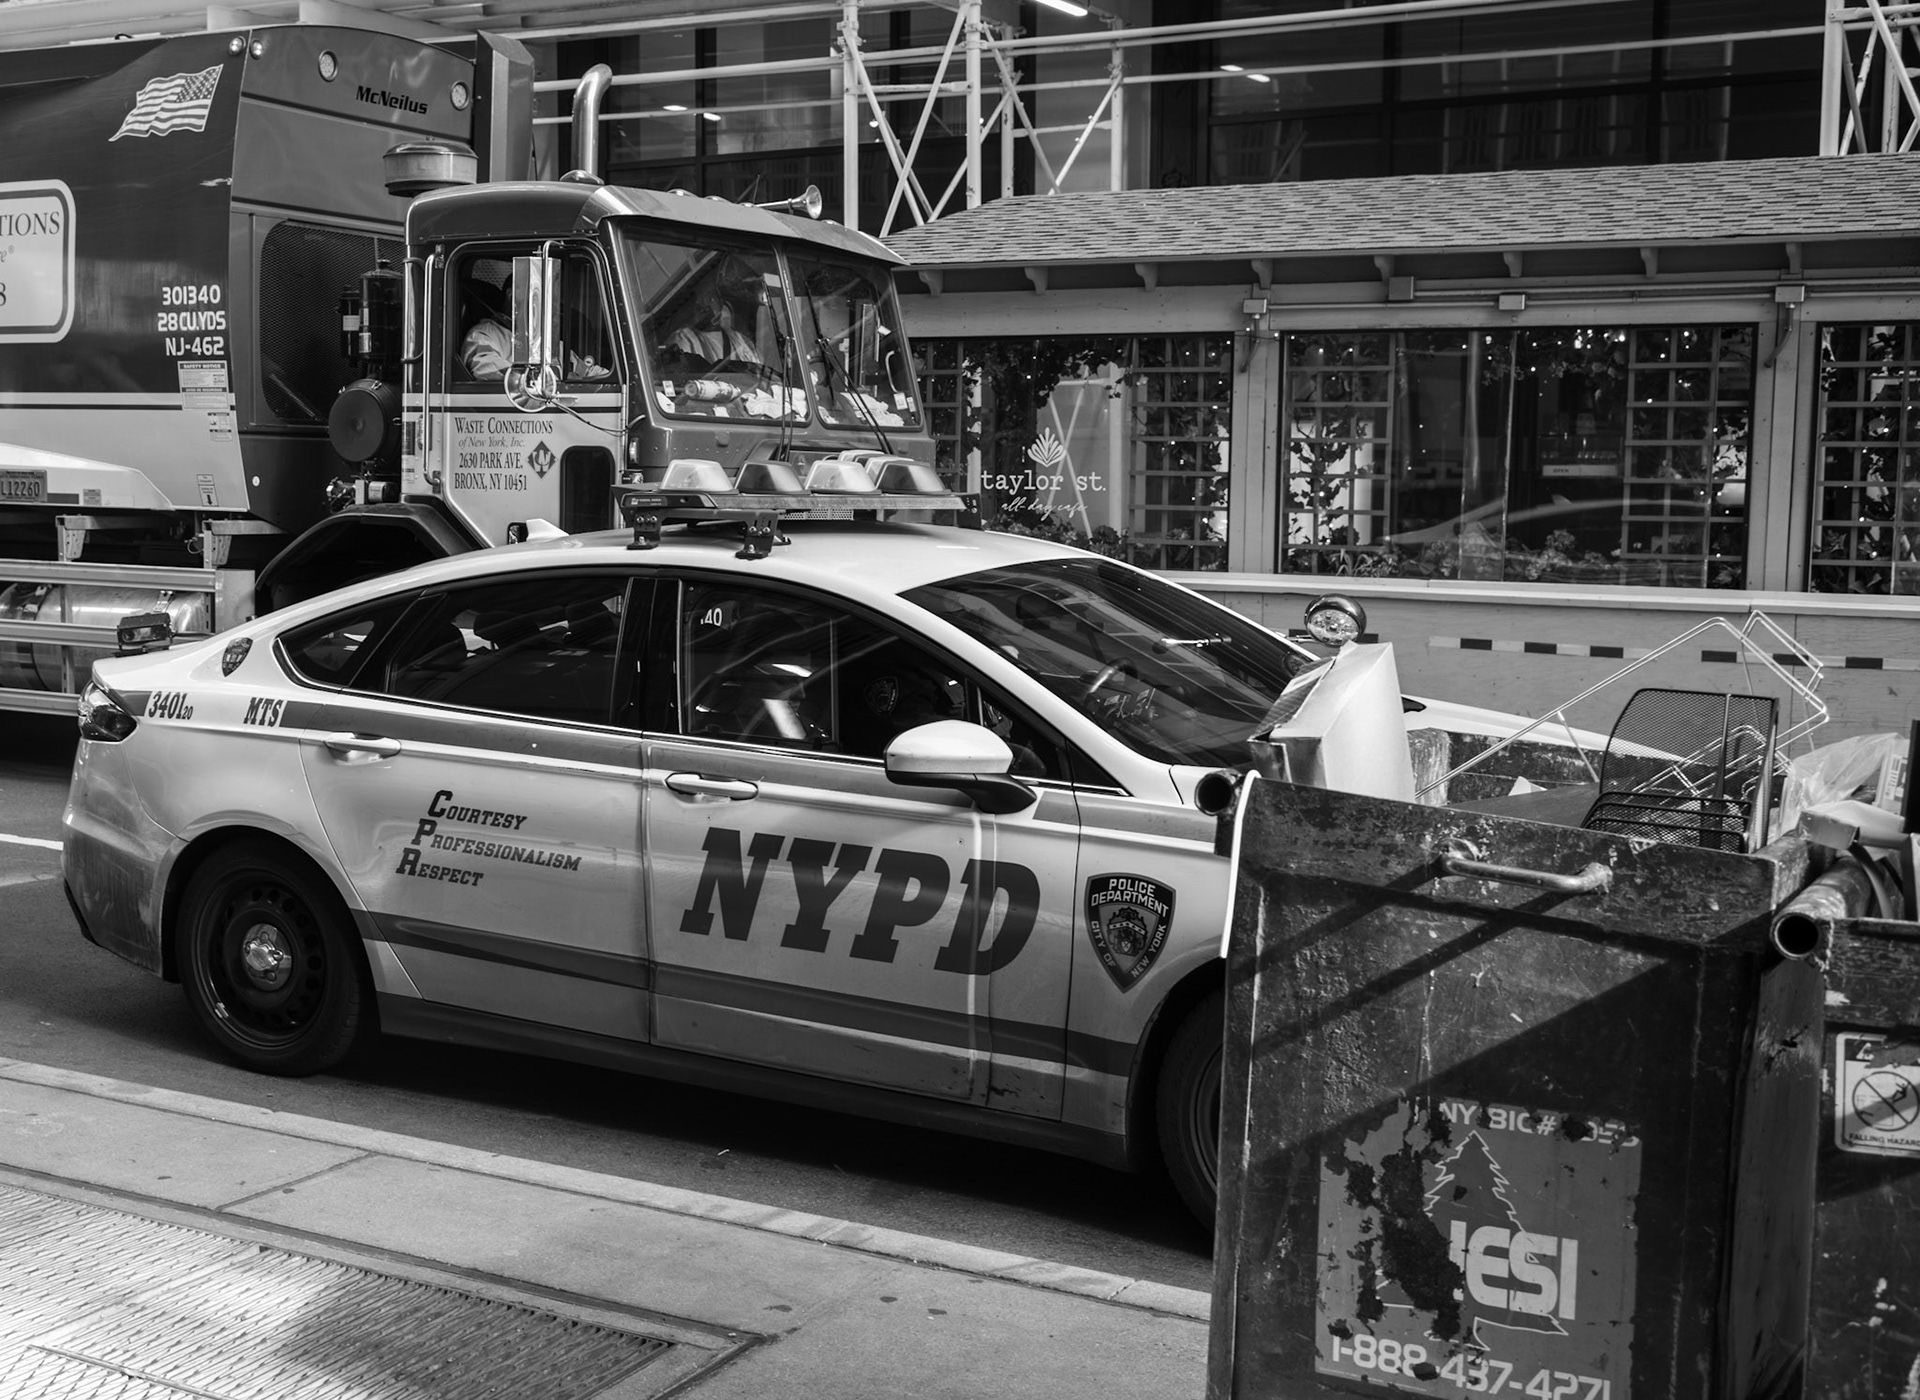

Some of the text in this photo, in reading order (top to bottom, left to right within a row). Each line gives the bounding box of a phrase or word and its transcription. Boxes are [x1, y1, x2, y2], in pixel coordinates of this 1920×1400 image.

[355, 85, 429, 115] McNeilus
[162, 284, 221, 305] 301340
[165, 336, 225, 356] NJ-462
[454, 416, 553, 434] WASTE CONNECTIONS
[468, 437, 485, 447] New
[459, 452, 523, 468] 2630 PARK AVE.
[454, 472, 527, 491] BRONX, NY 10451
[981, 470, 1106, 495] taylor st.
[243, 697, 283, 727] MTS
[427, 789, 527, 830] COURTESY
[410, 818, 582, 872] PROFESSIONALISM
[395, 847, 484, 887] RESPECT
[1108, 878, 1156, 897] POLICE
[679, 826, 1041, 976] NYPD
[1091, 890, 1169, 917] DEPARTMENT
[1091, 921, 1116, 967] CITY OF
[1130, 924, 1167, 978] NEW YORK
[1439, 1102, 1477, 1125] NY
